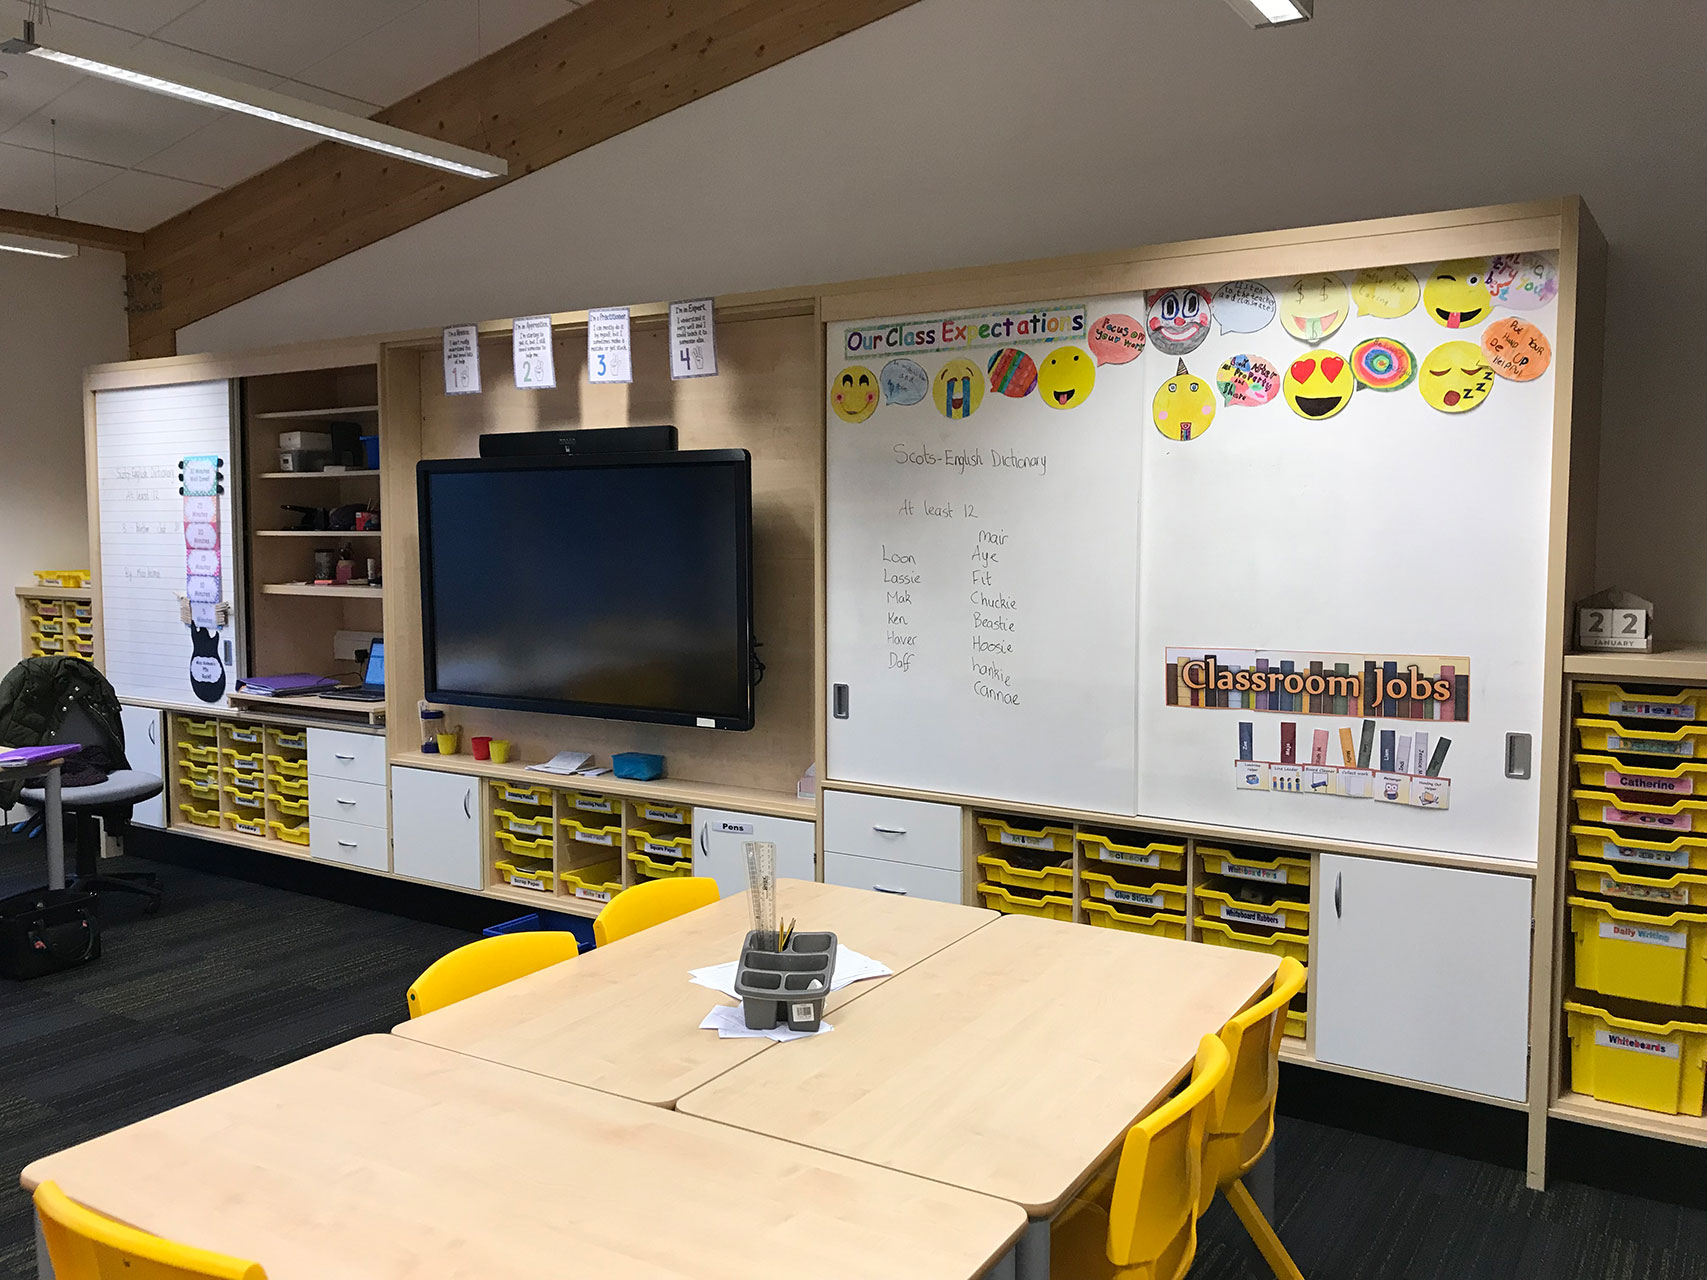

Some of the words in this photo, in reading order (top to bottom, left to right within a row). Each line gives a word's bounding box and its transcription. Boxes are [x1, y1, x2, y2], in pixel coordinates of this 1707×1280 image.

[848, 331, 883, 351] Our
[886, 325, 935, 347] Class
[942, 312, 1084, 346] Expectations
[1131, 331, 1145, 341] on
[597, 354, 606, 376] 3
[680, 347, 690, 370] 4
[452, 367, 458, 388] 1
[523, 361, 532, 382] 2
[893, 443, 983, 475] Scots-English
[991, 447, 1047, 476] Dictionary
[899, 499, 914, 516] At
[924, 500, 954, 518] least
[964, 503, 979, 518] 12
[882, 545, 916, 565] Loon
[971, 545, 999, 568] Aye
[883, 568, 921, 585] Lassie
[972, 569, 993, 586] Fit
[886, 590, 912, 604] Mak
[970, 591, 1017, 610] Chuckie
[887, 612, 908, 626] Ken
[973, 611, 1015, 632] Beastie
[1588, 611, 1604, 632] 2
[1621, 613, 1638, 634] 2
[972, 635, 1013, 654] Hoosie
[1594, 639, 1635, 647] JANUARY
[1181, 658, 1361, 698] Classroom
[1371, 664, 1452, 709] Jobs
[1620, 776, 1675, 791] Catherine
[722, 823, 744, 832] Pens
[1114, 890, 1131, 901] Glue
[1132, 893, 1153, 904] Sticks
[1226, 908, 1256, 920] Whiteboard
[1256, 913, 1278, 924] Rubbers
[1613, 926, 1636, 938] Daily
[1637, 929, 1670, 943] Writing
[1608, 1034, 1666, 1053] Whiteboards
